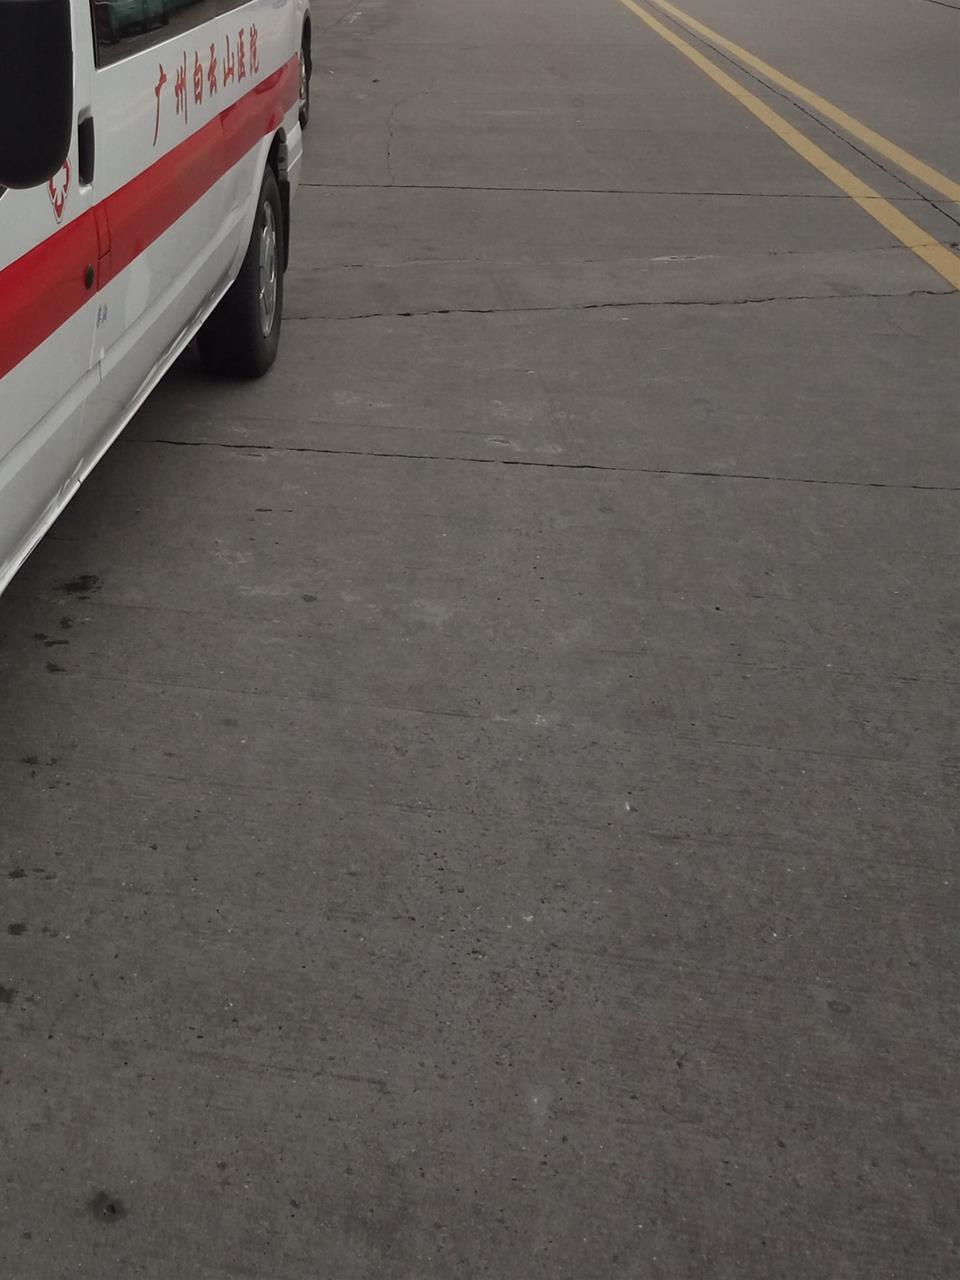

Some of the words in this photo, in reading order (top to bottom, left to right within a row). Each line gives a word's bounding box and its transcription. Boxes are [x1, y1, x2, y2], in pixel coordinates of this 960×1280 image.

[152, 23, 261, 147] 广州白云山医院
